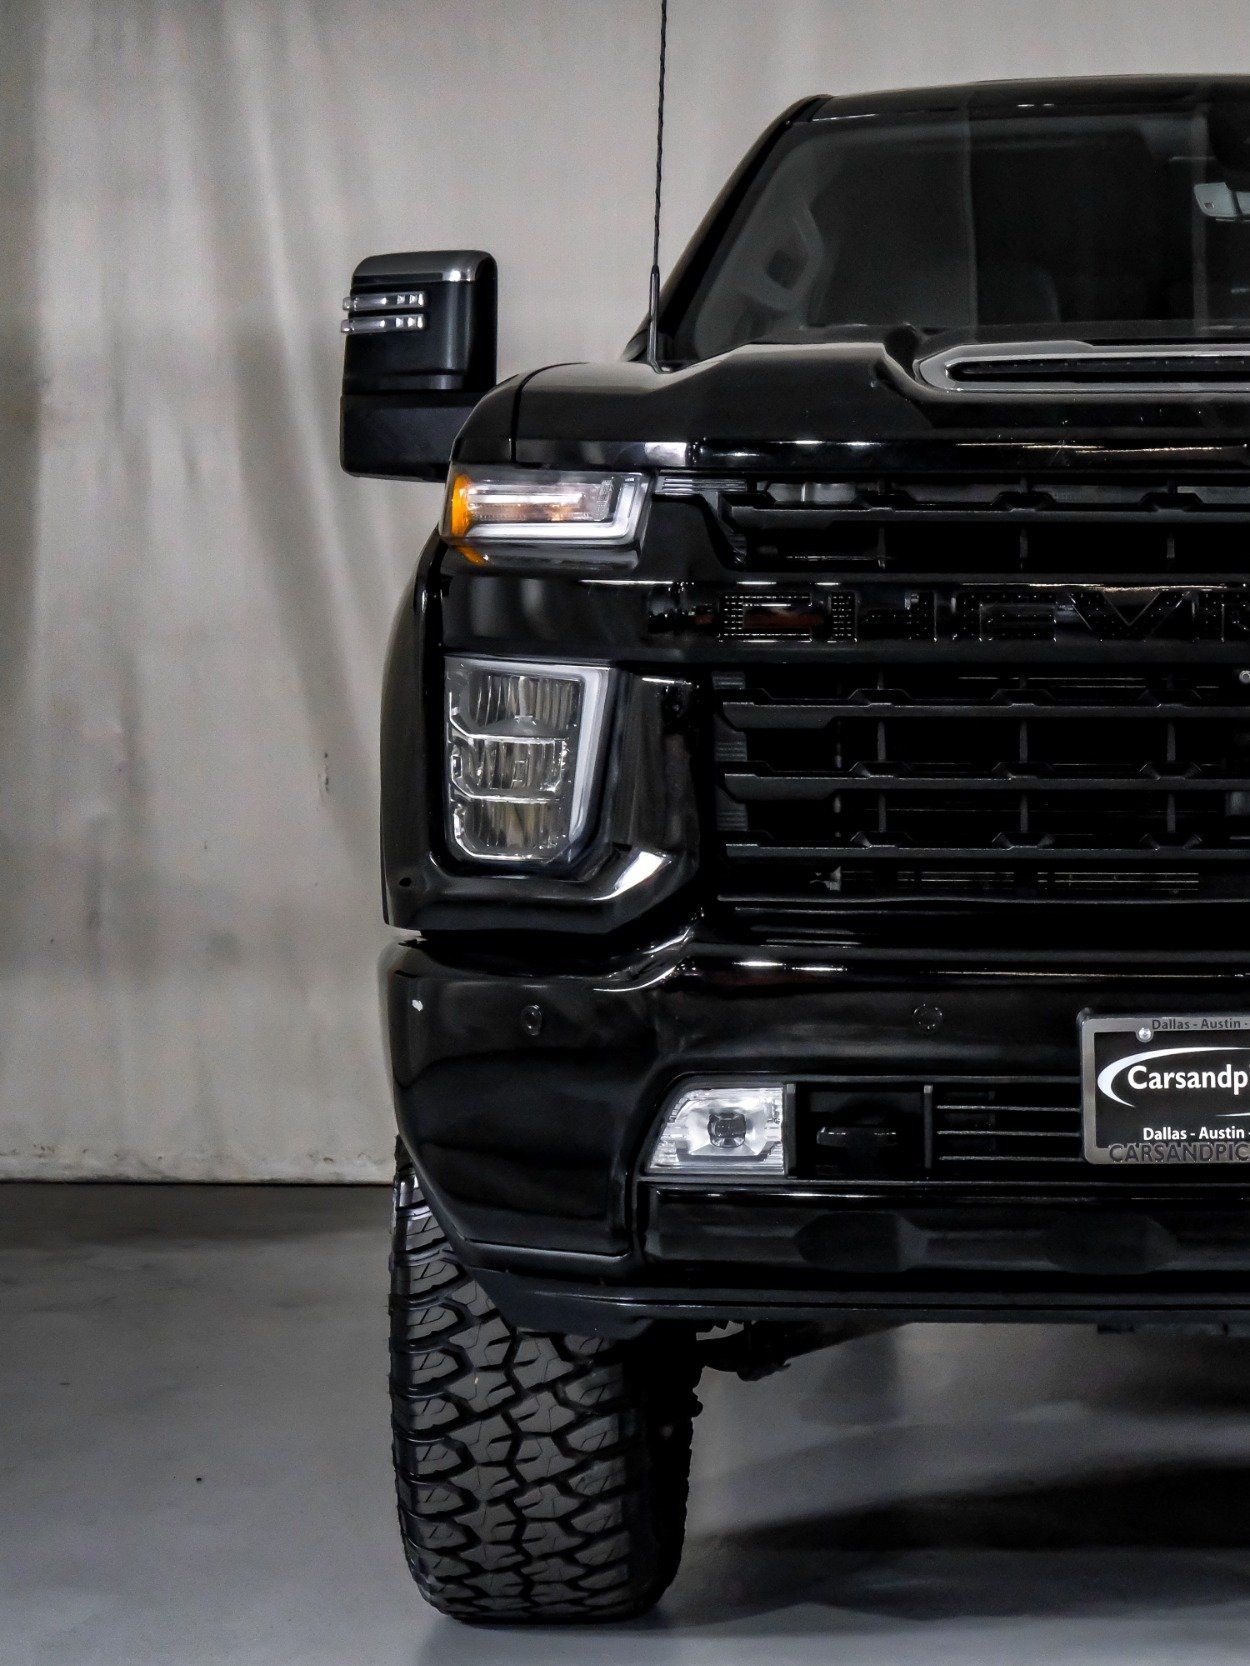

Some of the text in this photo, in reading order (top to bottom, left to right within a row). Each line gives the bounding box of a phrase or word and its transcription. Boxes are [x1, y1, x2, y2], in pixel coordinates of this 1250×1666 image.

[1151, 1019, 1190, 1030] Dallas
[1200, 1018, 1241, 1030] Austin
[1143, 1126, 1187, 1141] Dallas
[1199, 1126, 1245, 1140] Austin
